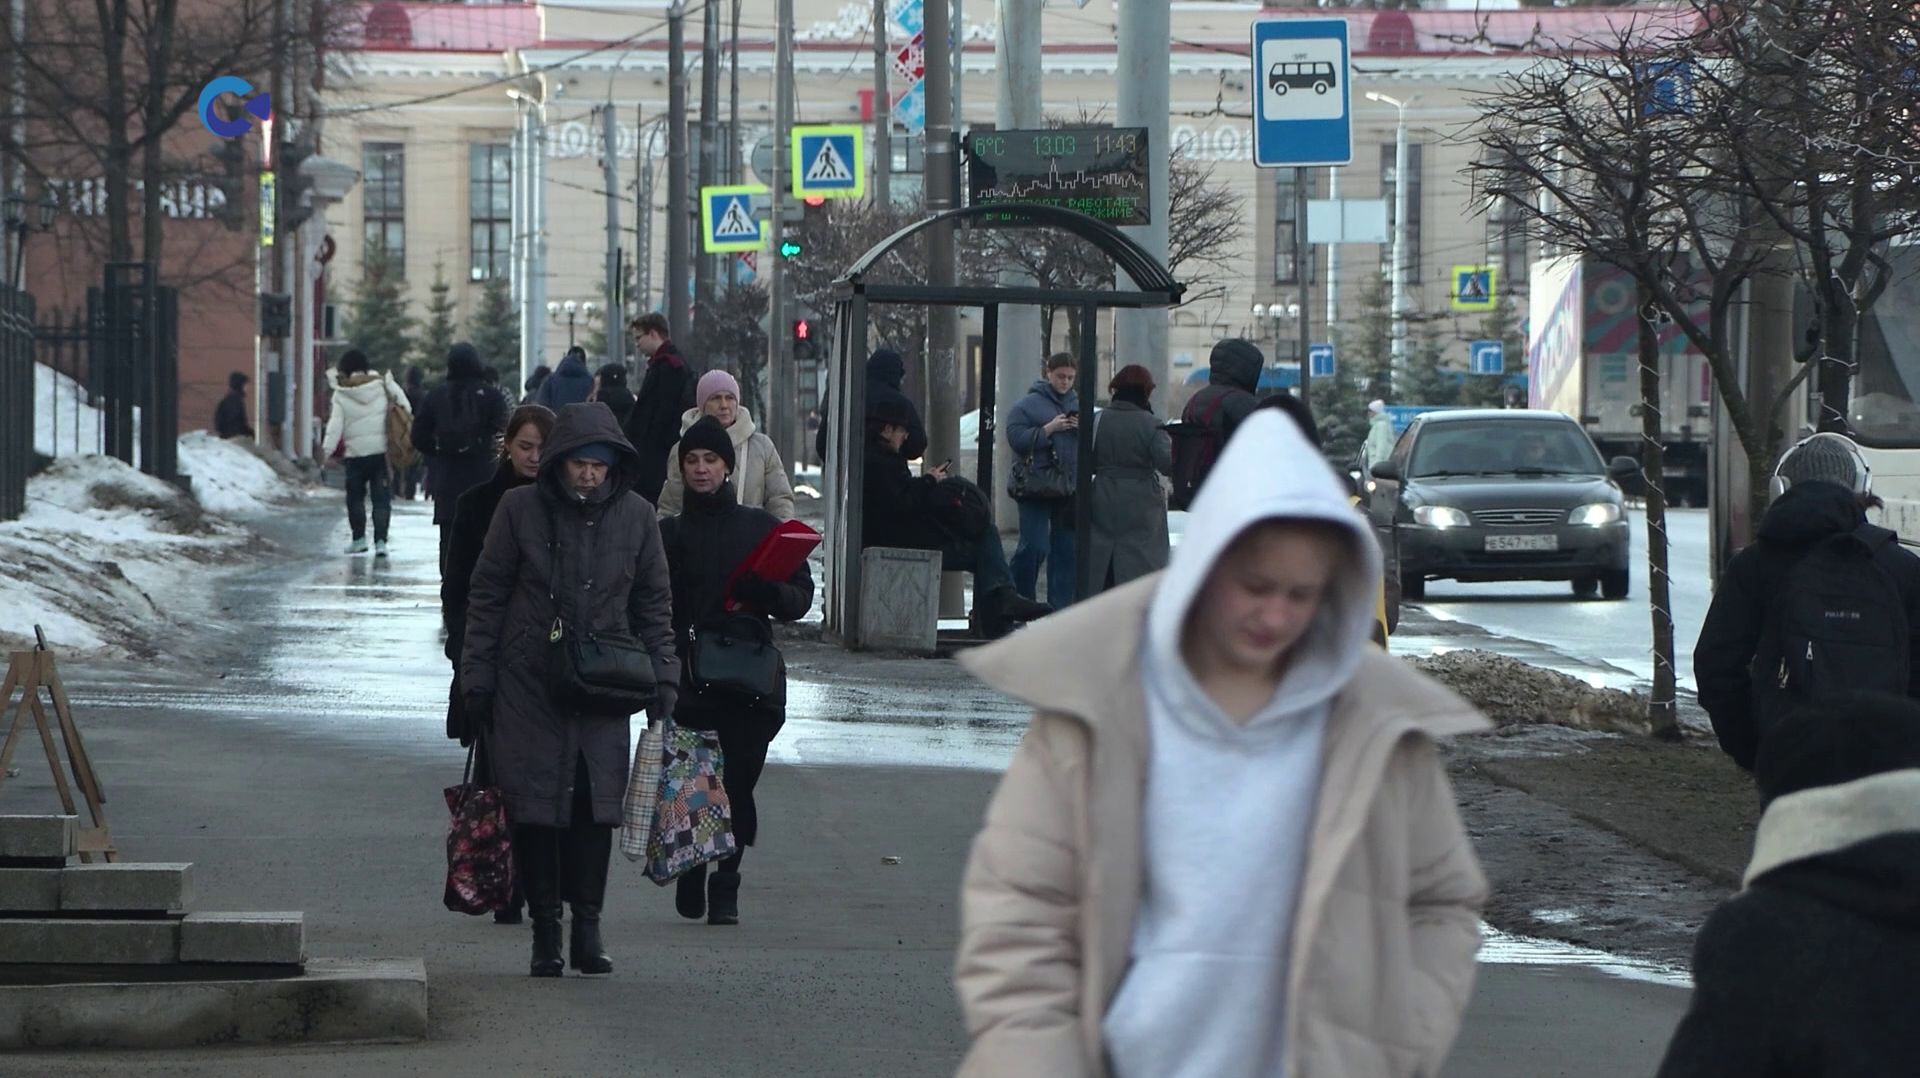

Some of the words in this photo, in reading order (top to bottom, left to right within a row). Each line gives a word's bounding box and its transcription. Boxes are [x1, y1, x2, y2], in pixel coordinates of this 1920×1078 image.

[1032, 135, 1076, 155] 13.03
[1093, 134, 1136, 154] 11:43
[1068, 196, 1140, 208] РАБОТАЕТ
